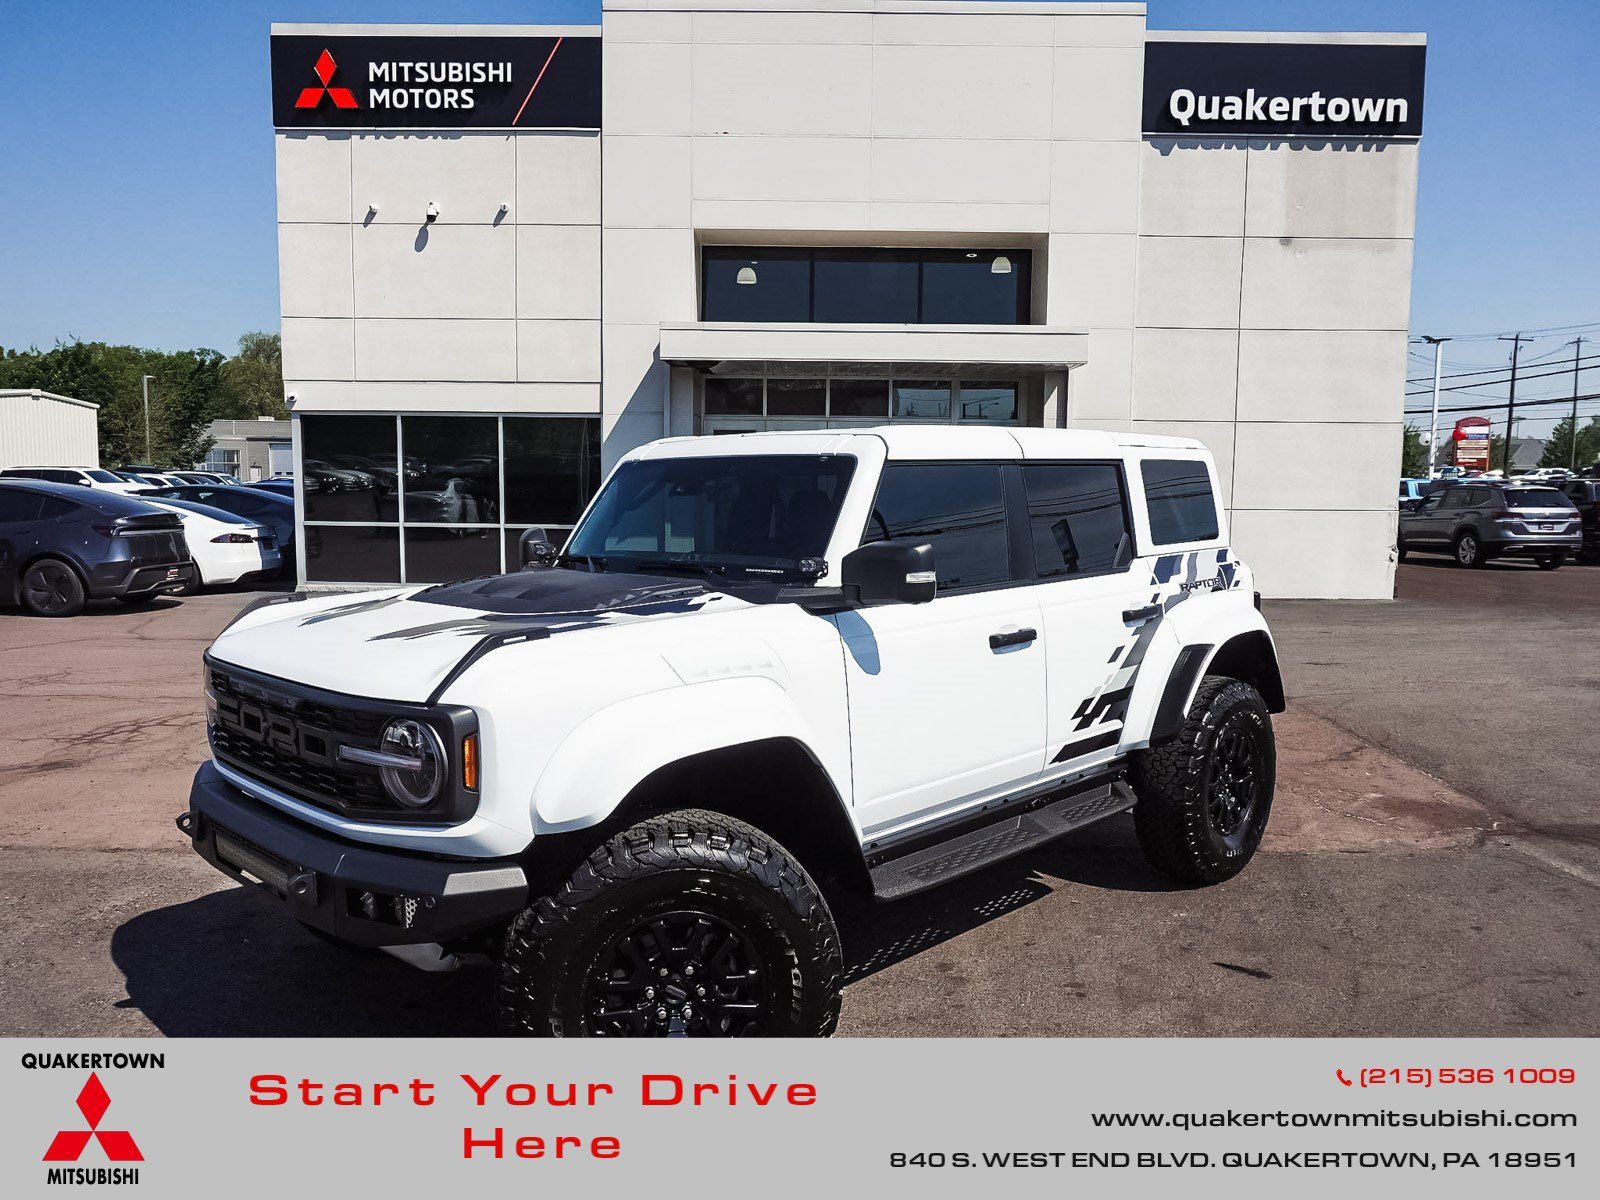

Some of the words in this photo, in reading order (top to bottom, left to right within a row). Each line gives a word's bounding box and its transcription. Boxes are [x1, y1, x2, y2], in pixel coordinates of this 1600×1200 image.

[368, 61, 512, 83] MITSUBISHI
[369, 88, 475, 109] MOTORS
[1170, 88, 1408, 126] Quakertown
[1180, 577, 1222, 594] RAPTOR
